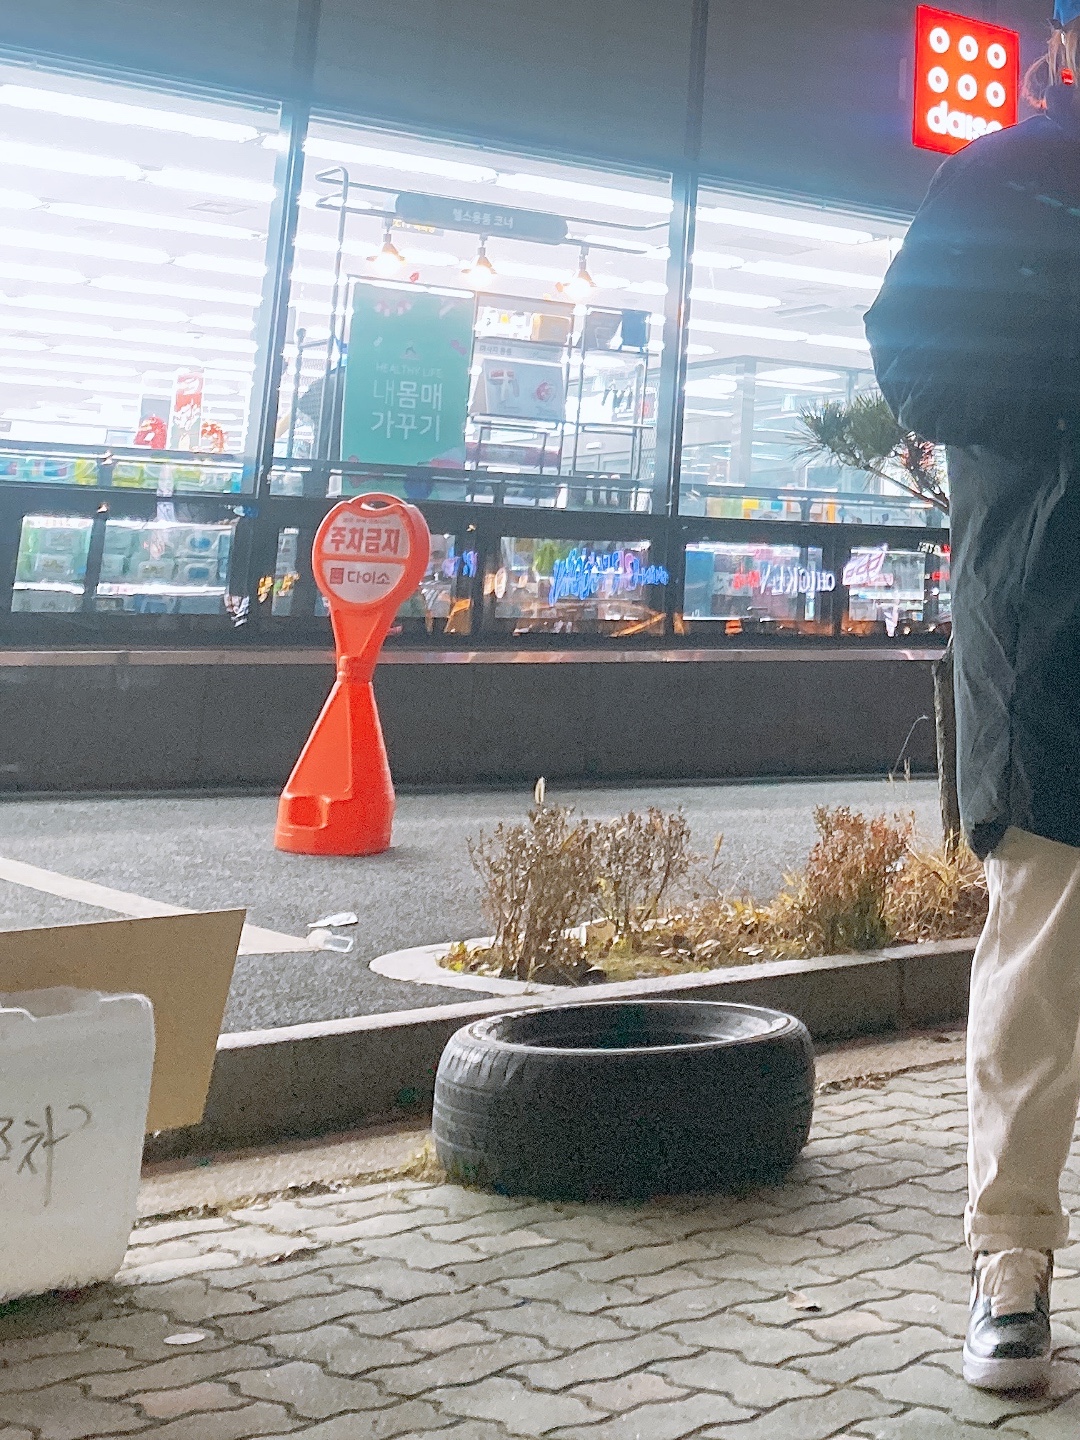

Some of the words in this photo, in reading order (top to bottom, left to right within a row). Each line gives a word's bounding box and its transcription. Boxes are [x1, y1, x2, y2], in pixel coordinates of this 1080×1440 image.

[493, 215, 514, 230] 코너
[375, 362, 420, 377] HEALTHY
[422, 365, 443, 379] LIFE
[370, 411, 441, 442] 가꾸기
[330, 526, 401, 555] 주차금지
[347, 570, 390, 585] 다이소
